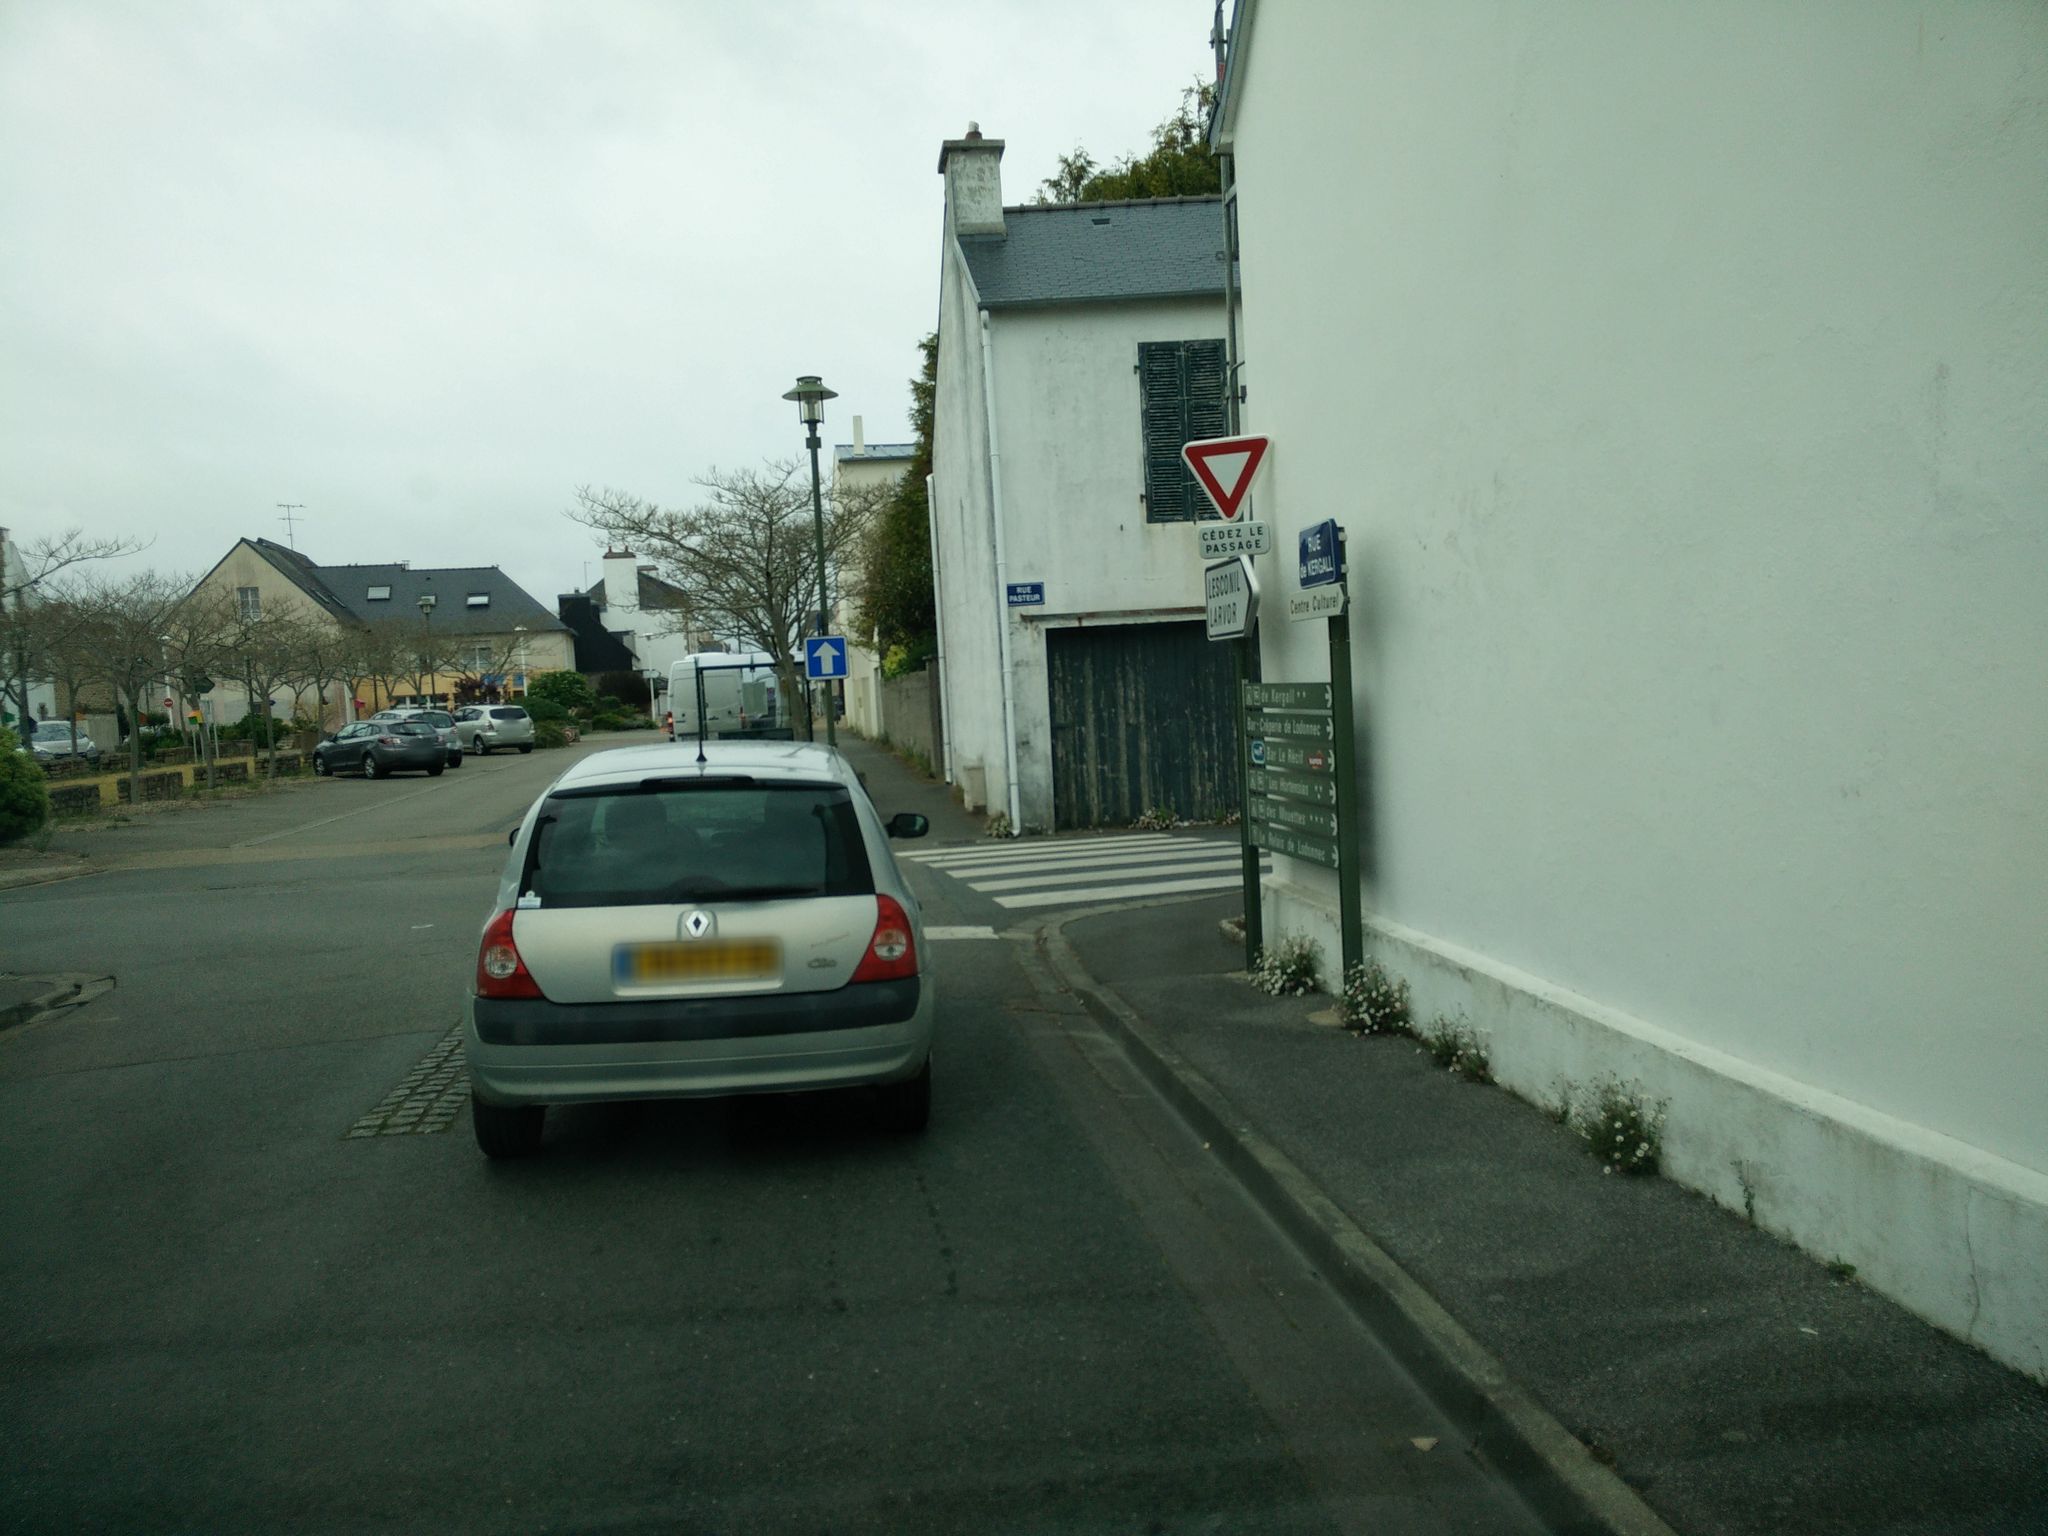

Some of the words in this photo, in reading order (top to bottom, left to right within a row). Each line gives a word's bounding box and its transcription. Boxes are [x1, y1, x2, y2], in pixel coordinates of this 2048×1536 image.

[1202, 528, 1242, 541] CÉDEZ
[1250, 526, 1263, 537] LE
[1206, 539, 1262, 554] PASSAGE
[1307, 534, 1321, 553] RUE
[1300, 565, 1307, 578] de
[1307, 555, 1334, 577] KERGALL
[1016, 586, 1032, 594] RUE
[1208, 570, 1240, 599] LESCONIL
[1009, 594, 1041, 602] PASTEUR
[1290, 600, 1309, 615] Centre
[1313, 593, 1339, 611] Culturel
[1210, 602, 1238, 628] LARVOR
[1272, 688, 1295, 707] Kergall
